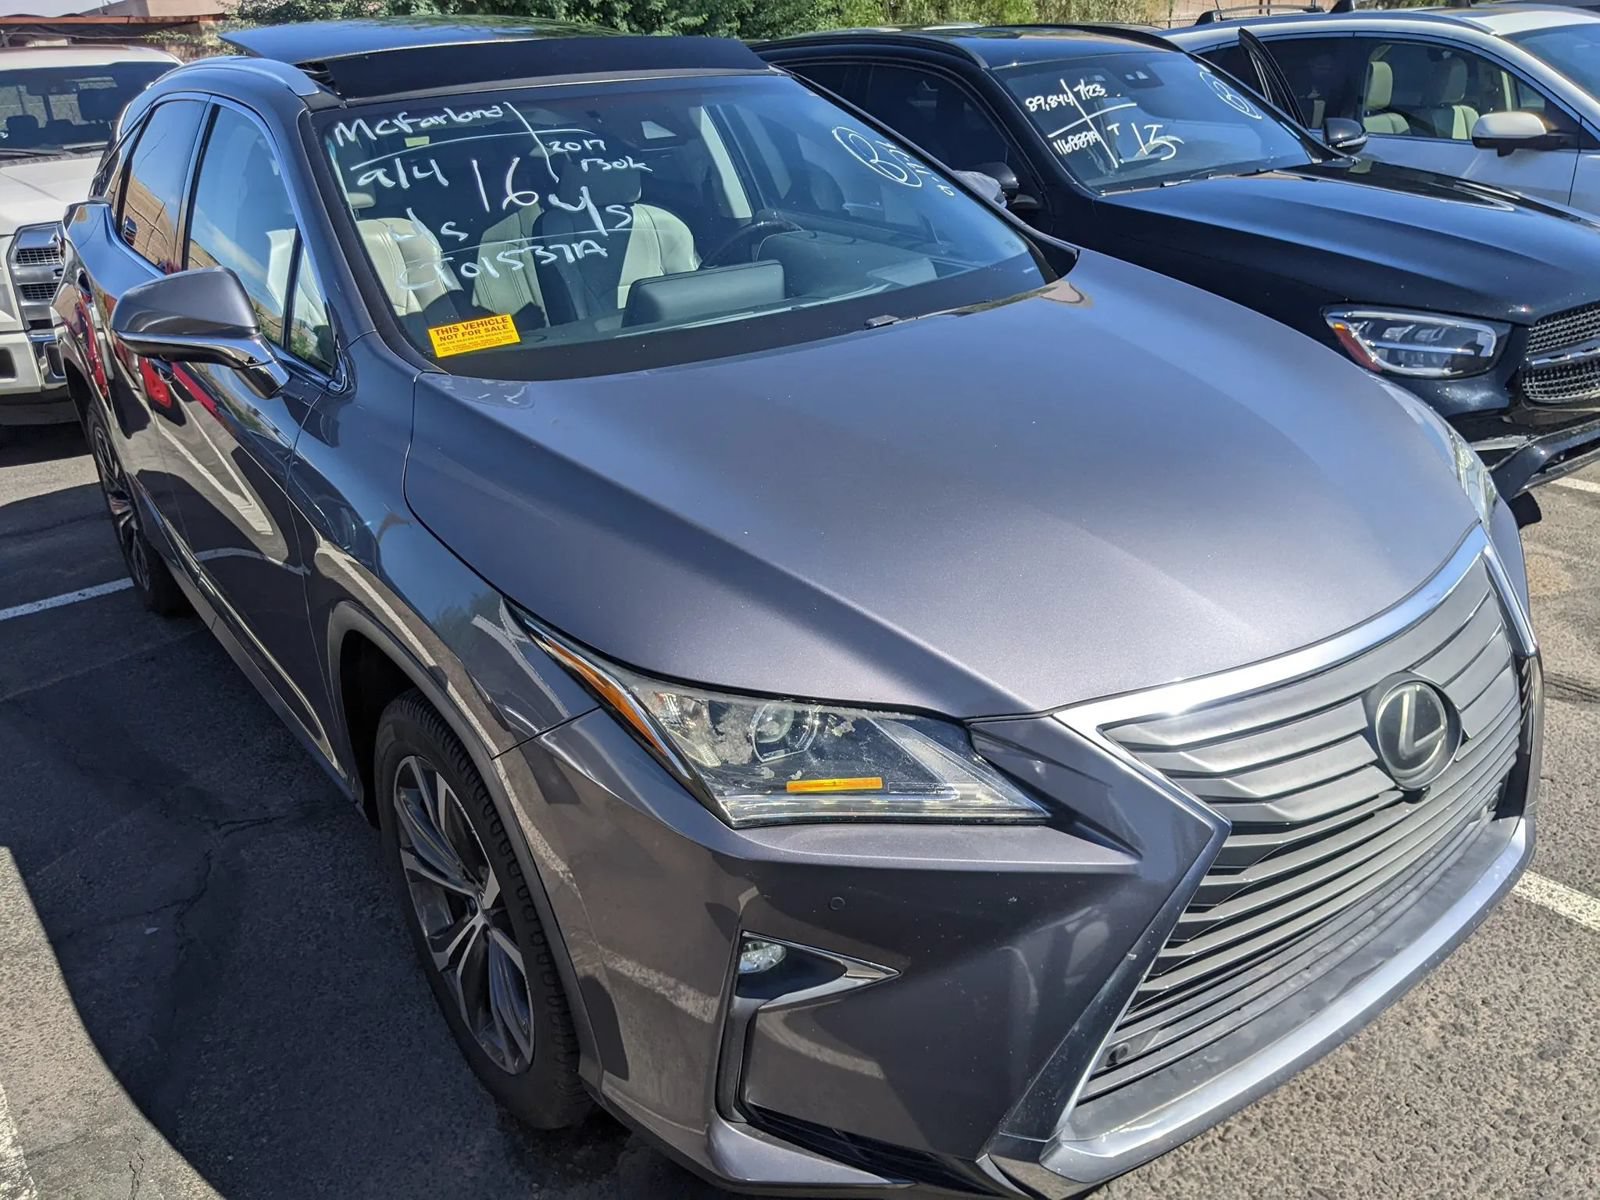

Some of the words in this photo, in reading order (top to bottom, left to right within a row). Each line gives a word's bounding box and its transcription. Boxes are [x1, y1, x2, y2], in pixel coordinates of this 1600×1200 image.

[435, 326, 460, 337] THIS
[462, 316, 509, 331] VEHICLE
[439, 332, 460, 342] NOT
[462, 329, 482, 337] FOR
[484, 324, 509, 332] SALE
